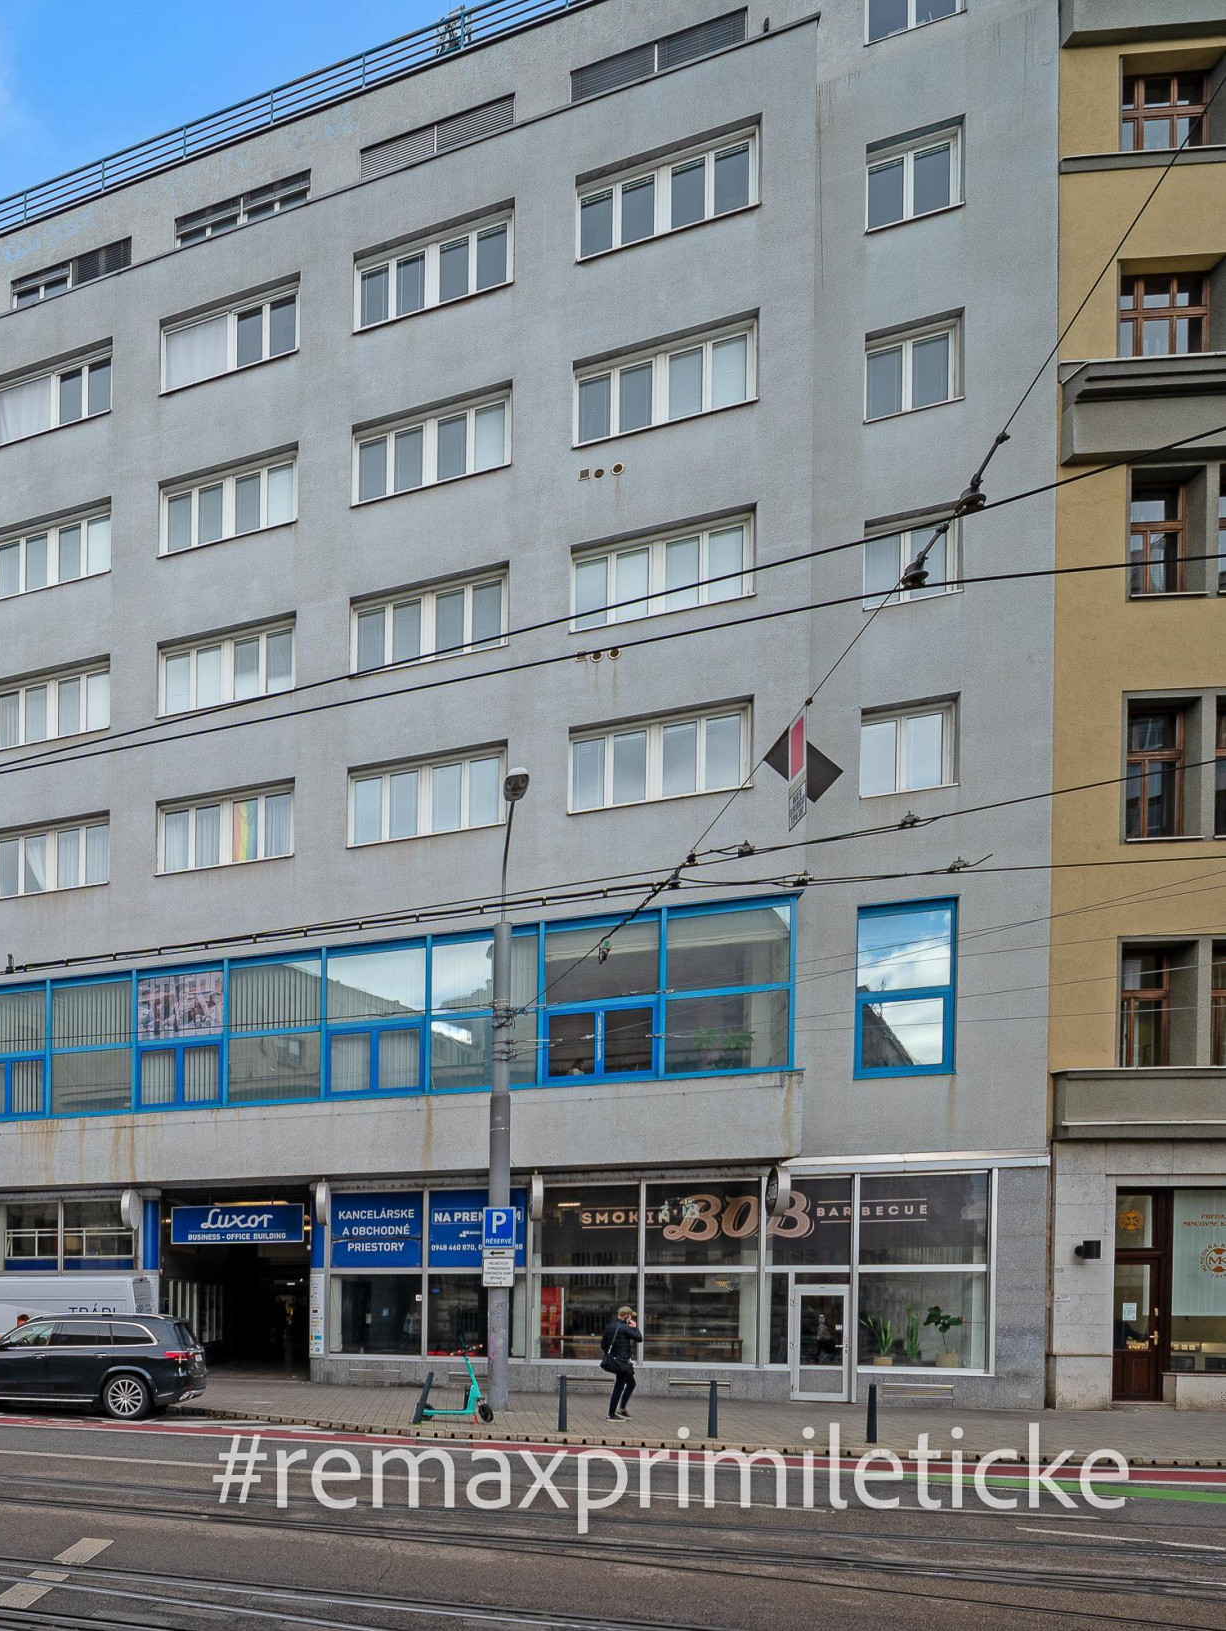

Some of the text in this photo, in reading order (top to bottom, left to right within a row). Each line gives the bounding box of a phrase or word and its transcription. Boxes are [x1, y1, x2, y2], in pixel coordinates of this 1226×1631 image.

[200, 1208, 273, 1229] Luxor
[338, 1207, 415, 1220] KANCELÁRSKE
[434, 1212, 451, 1222] NA
[663, 1190, 815, 1241] BOB
[816, 1204, 928, 1217] BARBECUE
[492, 1211, 507, 1234] P
[253, 1232, 287, 1240] BUILDING
[342, 1223, 411, 1236] A OBCHODNÉ
[347, 1242, 405, 1252] PRIESTORY
[485, 1237, 513, 1245] RÉSERVÉ
